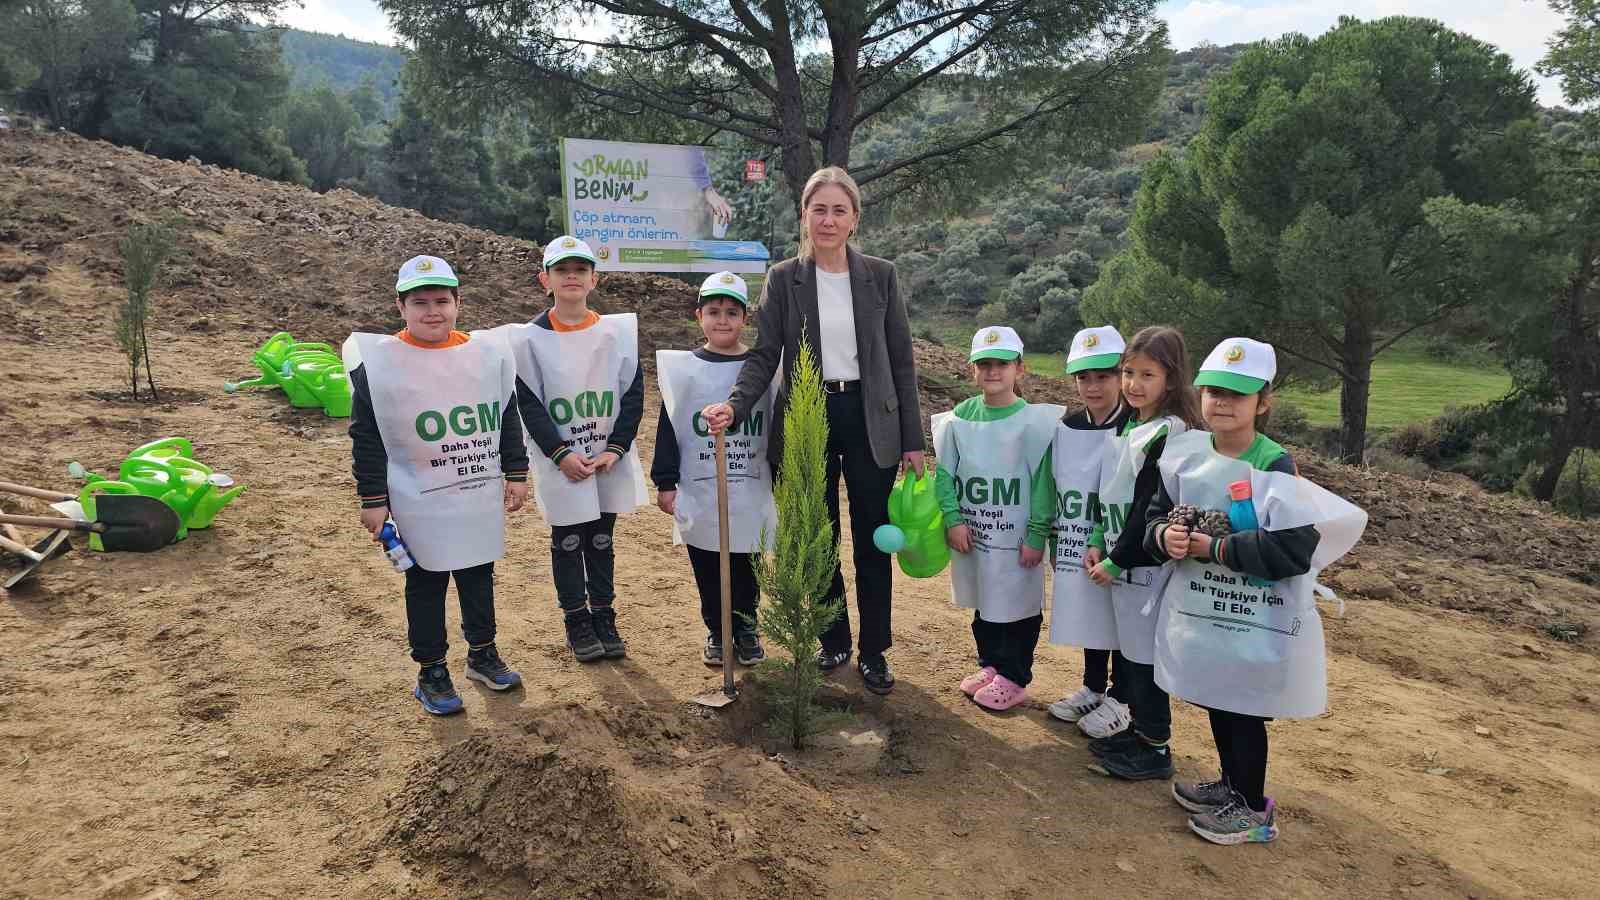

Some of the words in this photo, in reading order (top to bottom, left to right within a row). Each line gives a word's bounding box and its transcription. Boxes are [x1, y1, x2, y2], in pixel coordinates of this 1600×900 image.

[573, 154, 648, 181] ORMAN
[574, 210, 599, 225] Çöp
[603, 211, 656, 226] atmam,
[415, 401, 501, 442] OGM
[441, 442, 469, 453] Daha
[471, 437, 492, 449] Yeşil
[732, 440, 751, 449] Yeşil
[430, 458, 447, 468] Bir
[449, 451, 486, 466] Türkiye
[699, 452, 711, 461] Bir
[457, 467, 468, 476] El
[470, 464, 488, 474] Ele.
[729, 462, 746, 470] Ele.
[979, 509, 1003, 519] Yeşil
[996, 521, 1015, 531] İçin
[1063, 548, 1083, 559] Ele.
[1203, 570, 1236, 586] Daha
[1190, 581, 1205, 593] Bir
[1209, 586, 1258, 604] Türkiye
[1262, 592, 1284, 607] İçin
[1213, 601, 1226, 612] El
[1230, 603, 1256, 616] Ele.
